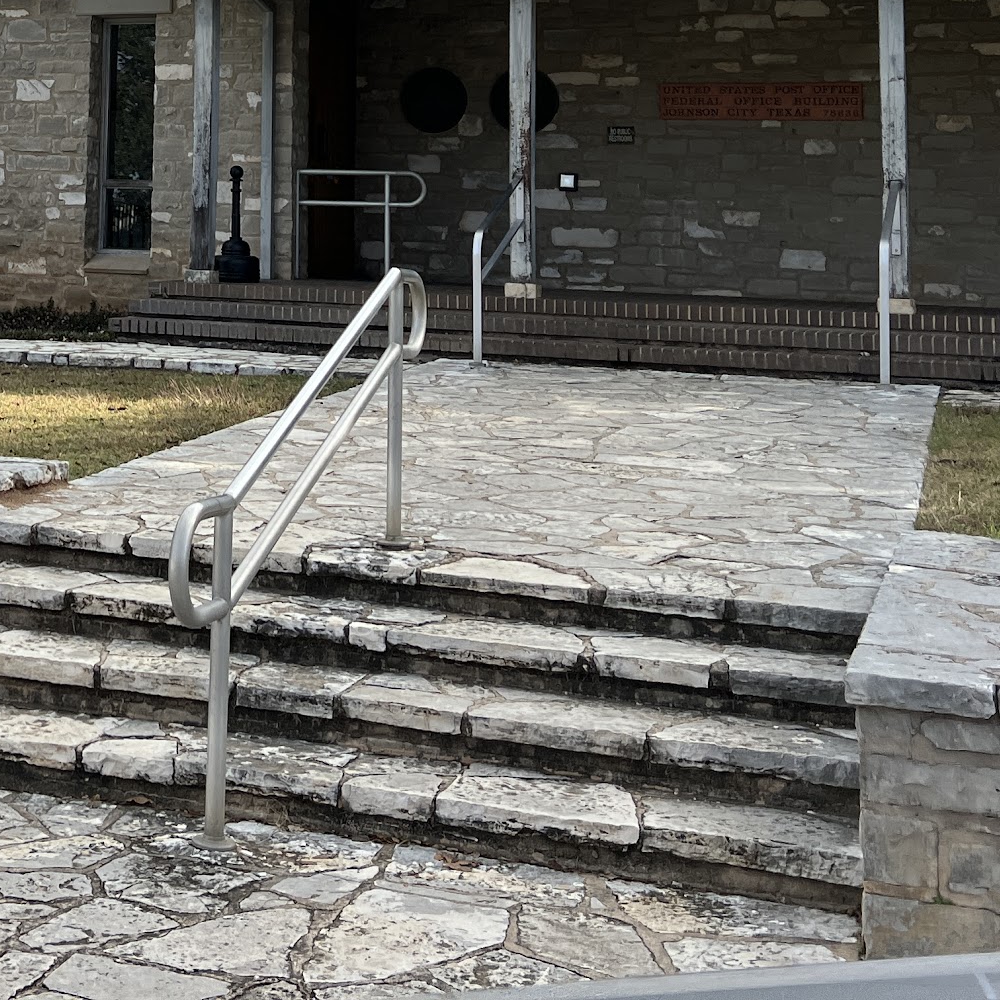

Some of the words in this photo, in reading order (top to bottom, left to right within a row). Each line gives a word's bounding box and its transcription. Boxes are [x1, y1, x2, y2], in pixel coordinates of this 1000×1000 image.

[663, 86, 711, 94] UNITED
[720, 86, 765, 94] STATES
[775, 85, 805, 94] POST
[813, 85, 860, 94] OFFICE
[663, 97, 722, 105] FEDERAL
[735, 97, 782, 105] OFFICE
[792, 96, 859, 106] BUILDING
[663, 108, 719, 116] JOHNSON
[727, 108, 759, 116] CITY
[767, 108, 810, 117] TEXAS
